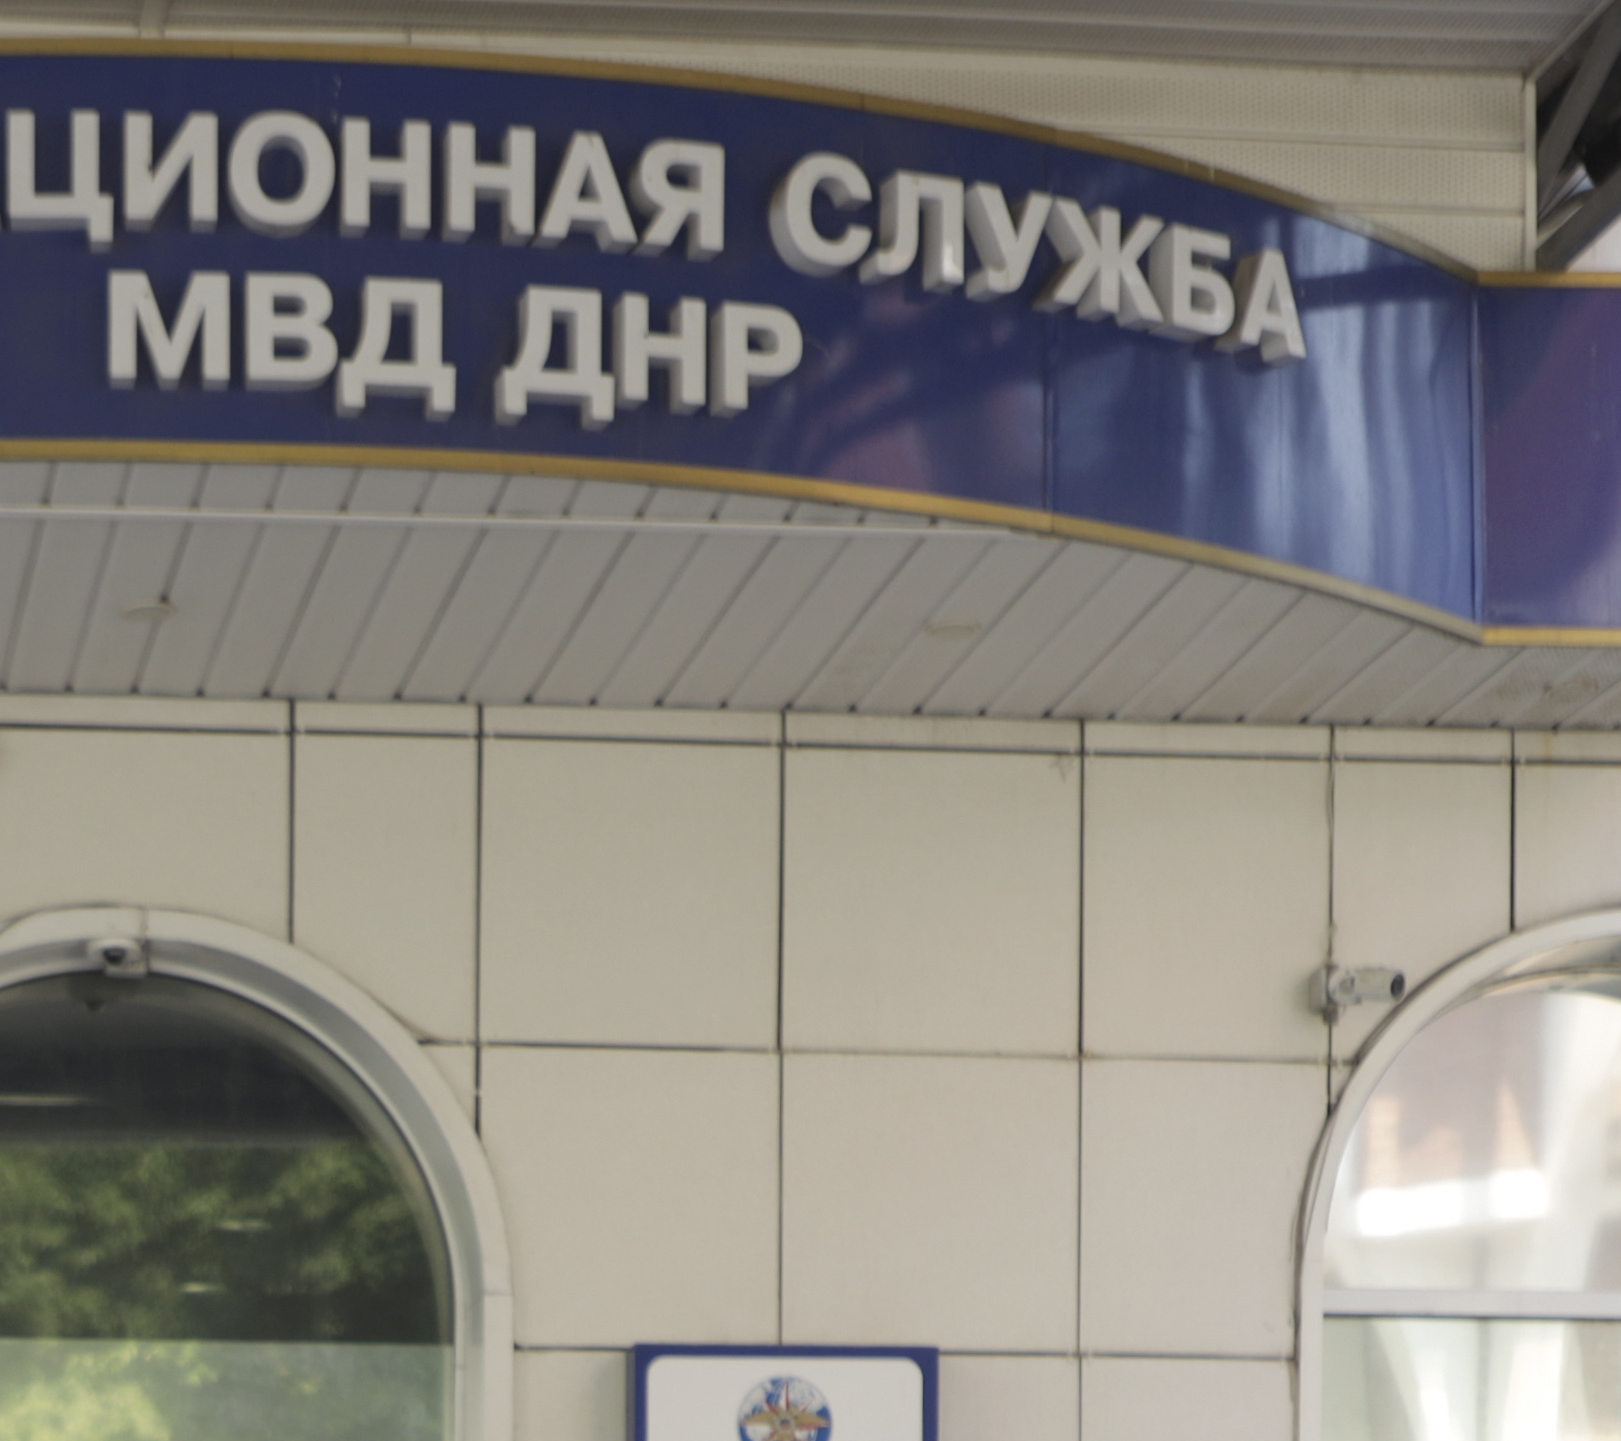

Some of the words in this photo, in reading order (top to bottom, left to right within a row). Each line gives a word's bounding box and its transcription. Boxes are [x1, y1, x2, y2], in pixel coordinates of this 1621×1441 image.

[108, 270, 457, 423] МВД
[494, 284, 804, 431] ДНР
[768, 151, 1308, 366] СЛУЖБА
